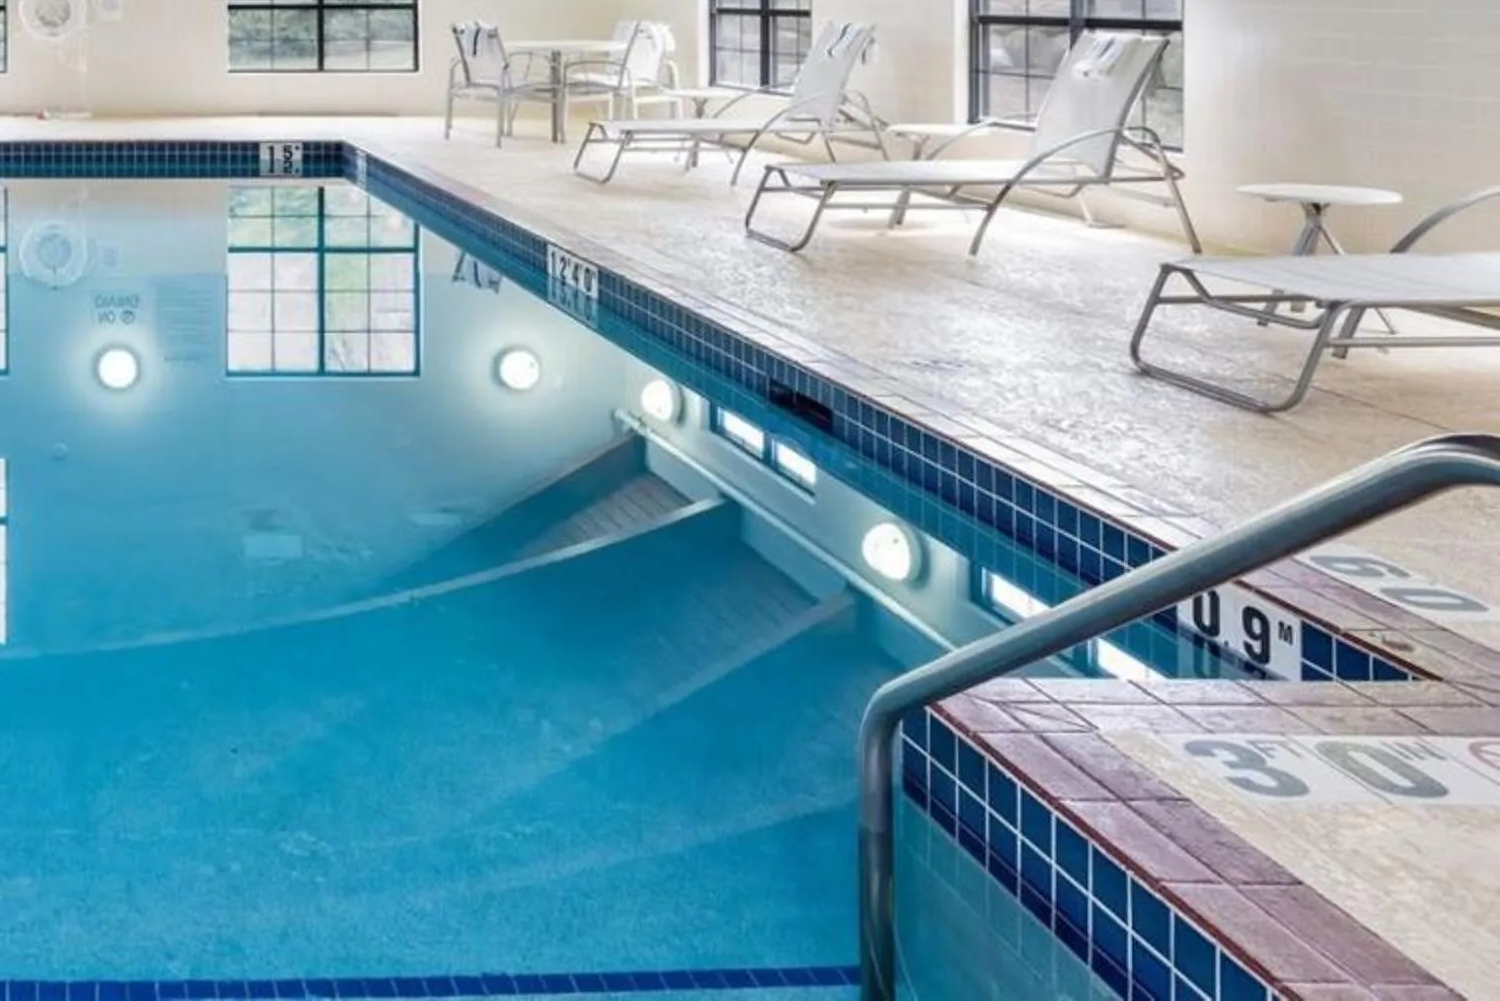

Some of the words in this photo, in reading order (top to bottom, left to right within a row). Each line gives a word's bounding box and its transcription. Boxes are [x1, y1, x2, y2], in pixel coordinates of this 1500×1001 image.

[1278, 620, 1294, 646] M
[1183, 739, 1310, 798] 3
[1313, 740, 1450, 799] 0
